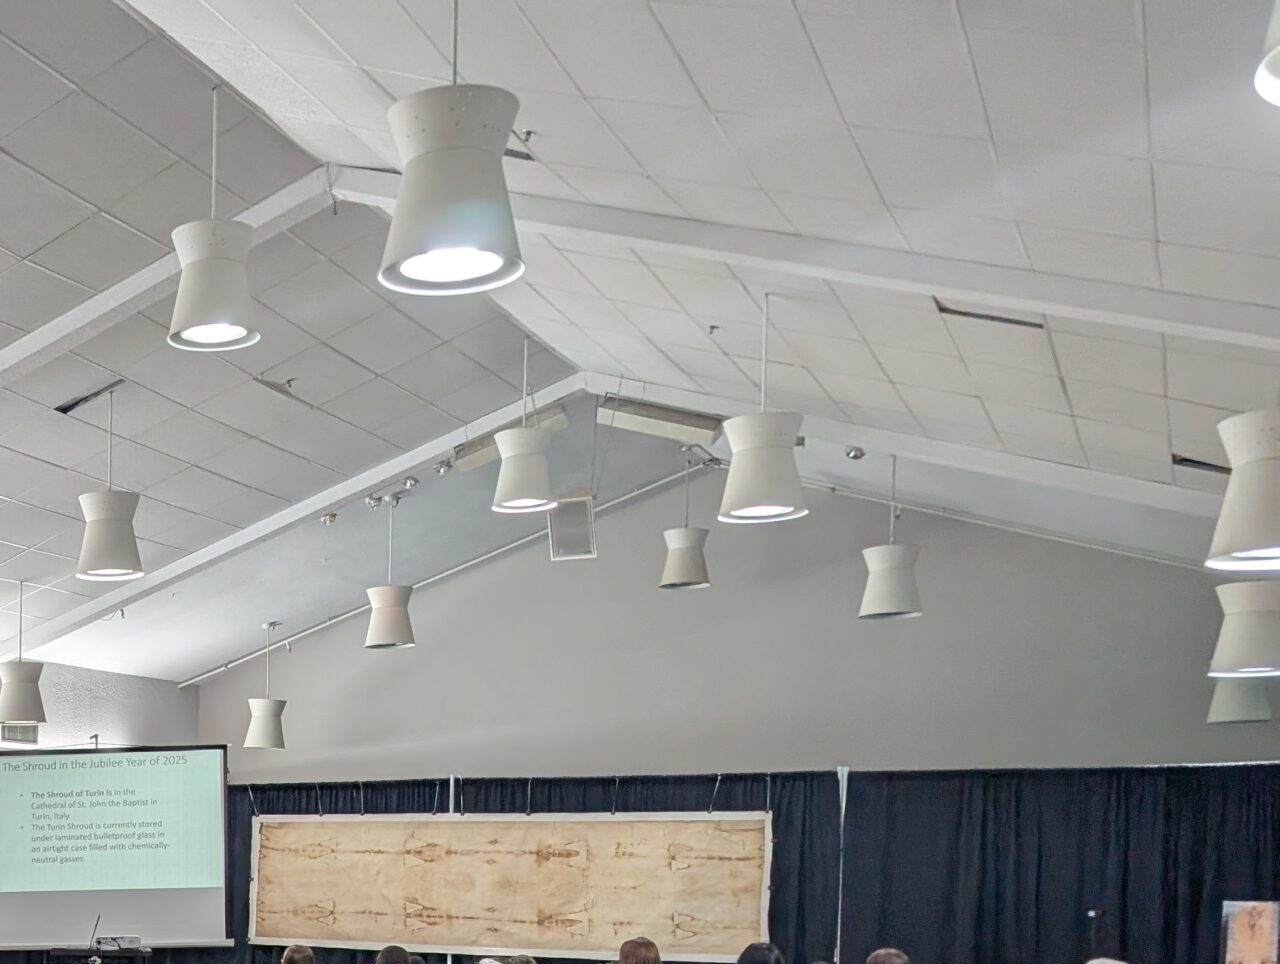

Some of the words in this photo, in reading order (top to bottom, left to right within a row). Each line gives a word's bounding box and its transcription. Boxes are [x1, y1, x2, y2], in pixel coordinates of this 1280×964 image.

[2, 762, 21, 772] The
[22, 761, 56, 771] Shroud
[59, 761, 68, 769] in
[71, 760, 87, 769] the
[89, 758, 124, 768] Jubilee
[126, 758, 147, 767] Year
[149, 756, 160, 766] of
[162, 755, 188, 765] 2025
[47, 790, 73, 798] Shroud
[85, 789, 105, 797] Turin
[31, 801, 67, 809] Cathedral
[68, 801, 76, 809] of
[108, 799, 121, 807] the
[122, 799, 148, 807] Baptist
[54, 812, 70, 820] Italy.
[67, 822, 94, 830] Shroud
[103, 821, 136, 829] currently
[138, 820, 162, 828] stored
[55, 833, 92, 841] laminated
[94, 831, 136, 841] bulletproof
[137, 831, 156, 840] glass
[42, 845, 69, 853] airtight
[128, 841, 171, 850] chemically-
[60, 856, 86, 864] gasses.
